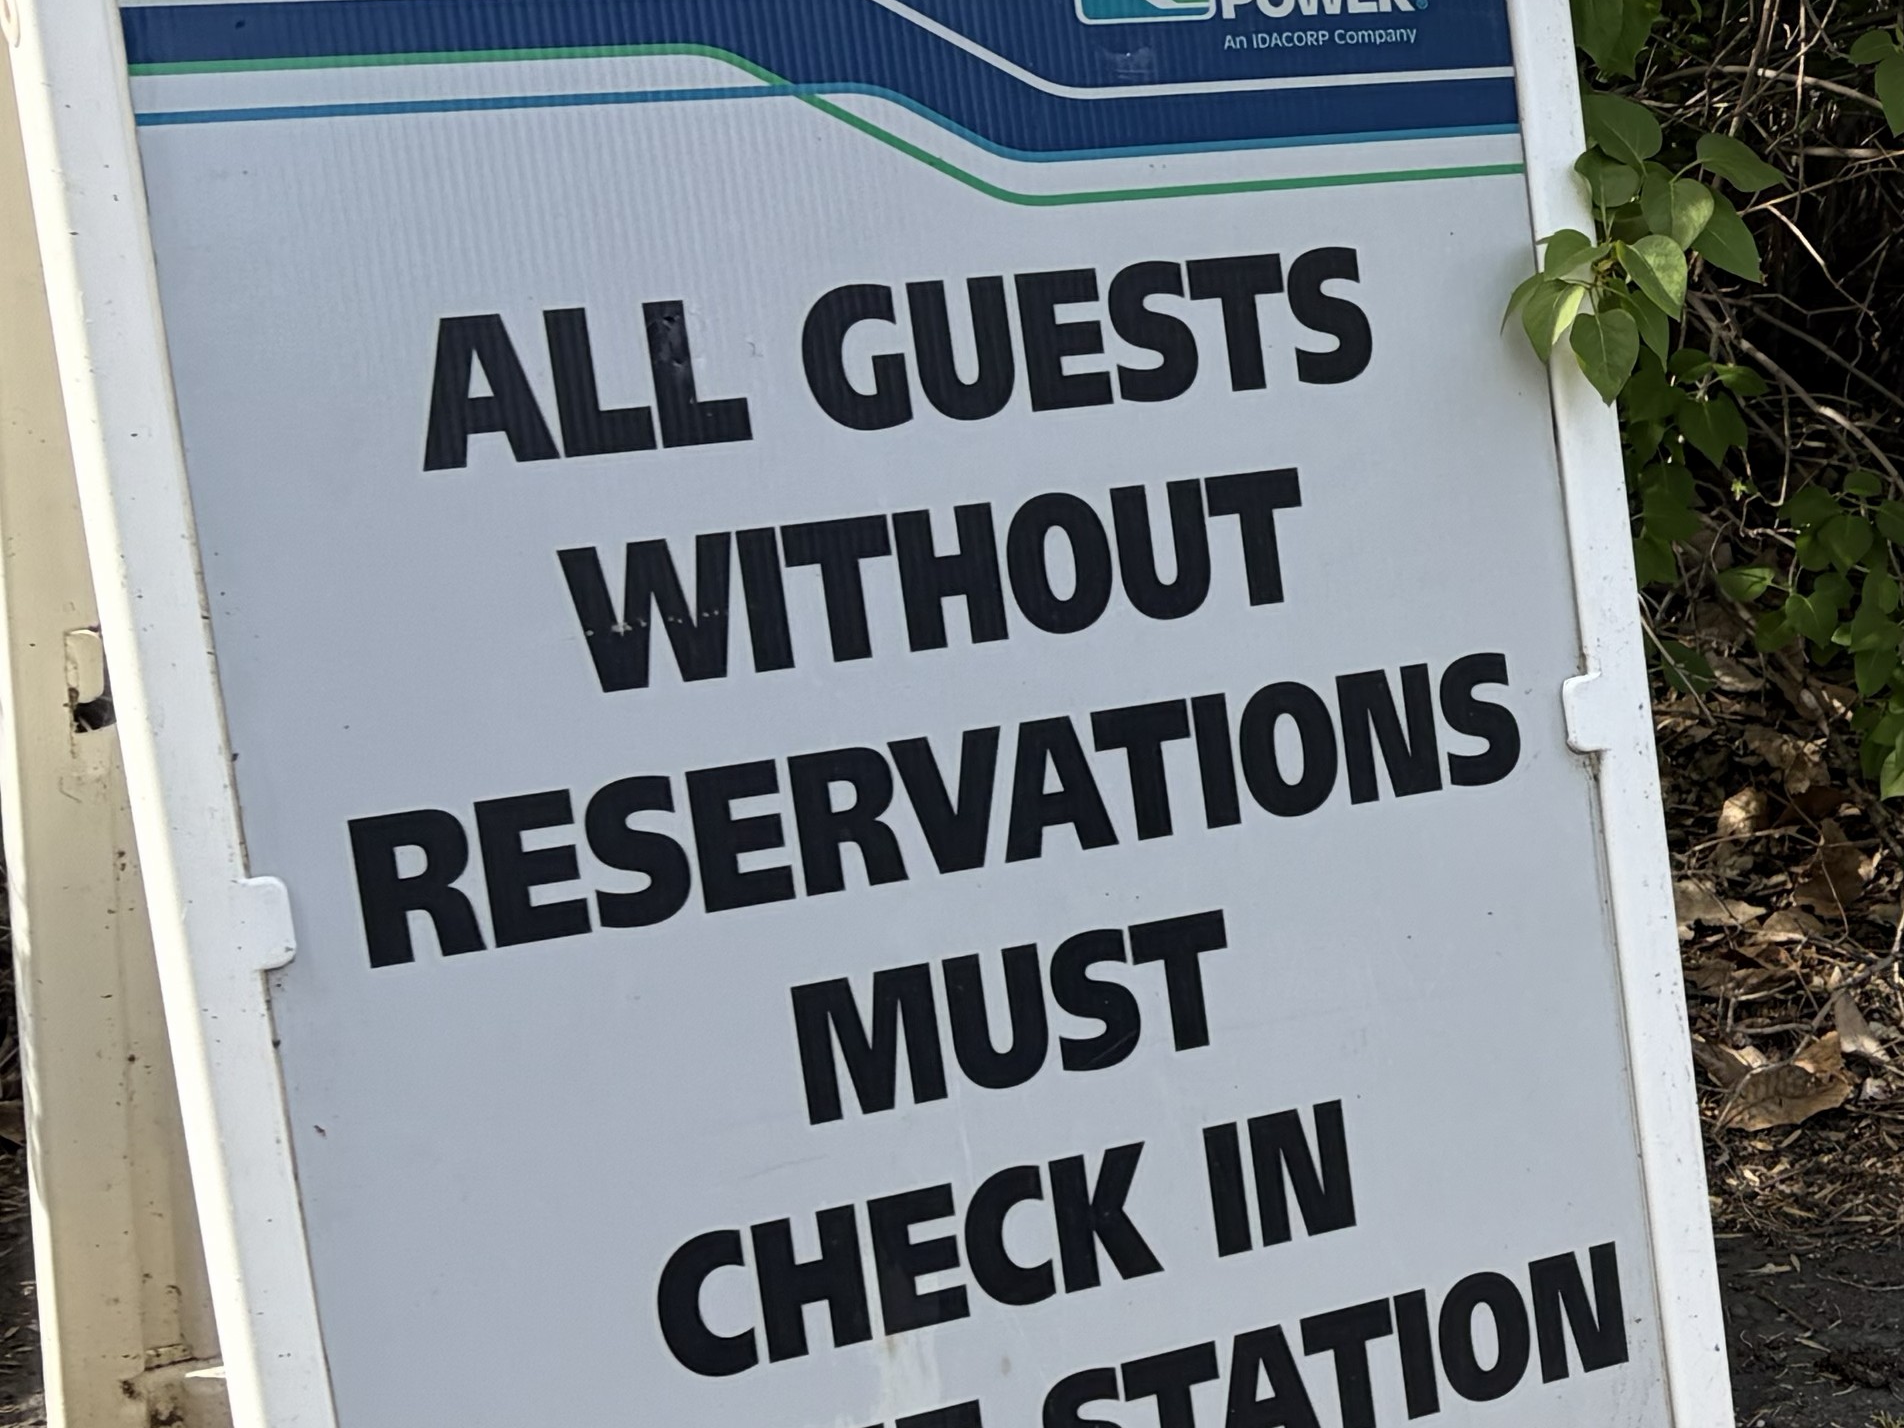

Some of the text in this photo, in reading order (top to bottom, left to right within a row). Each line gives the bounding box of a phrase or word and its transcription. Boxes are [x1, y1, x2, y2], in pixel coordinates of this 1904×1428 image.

[1224, 28, 1418, 50] An IDACORP Company
[424, 247, 1374, 471] ALL GUESTS
[557, 468, 1301, 693] WITHOUT
[348, 653, 1521, 968] RESERVATIONS
[791, 910, 1228, 1125] MUST
[658, 1100, 1356, 1376] CHECK IN
